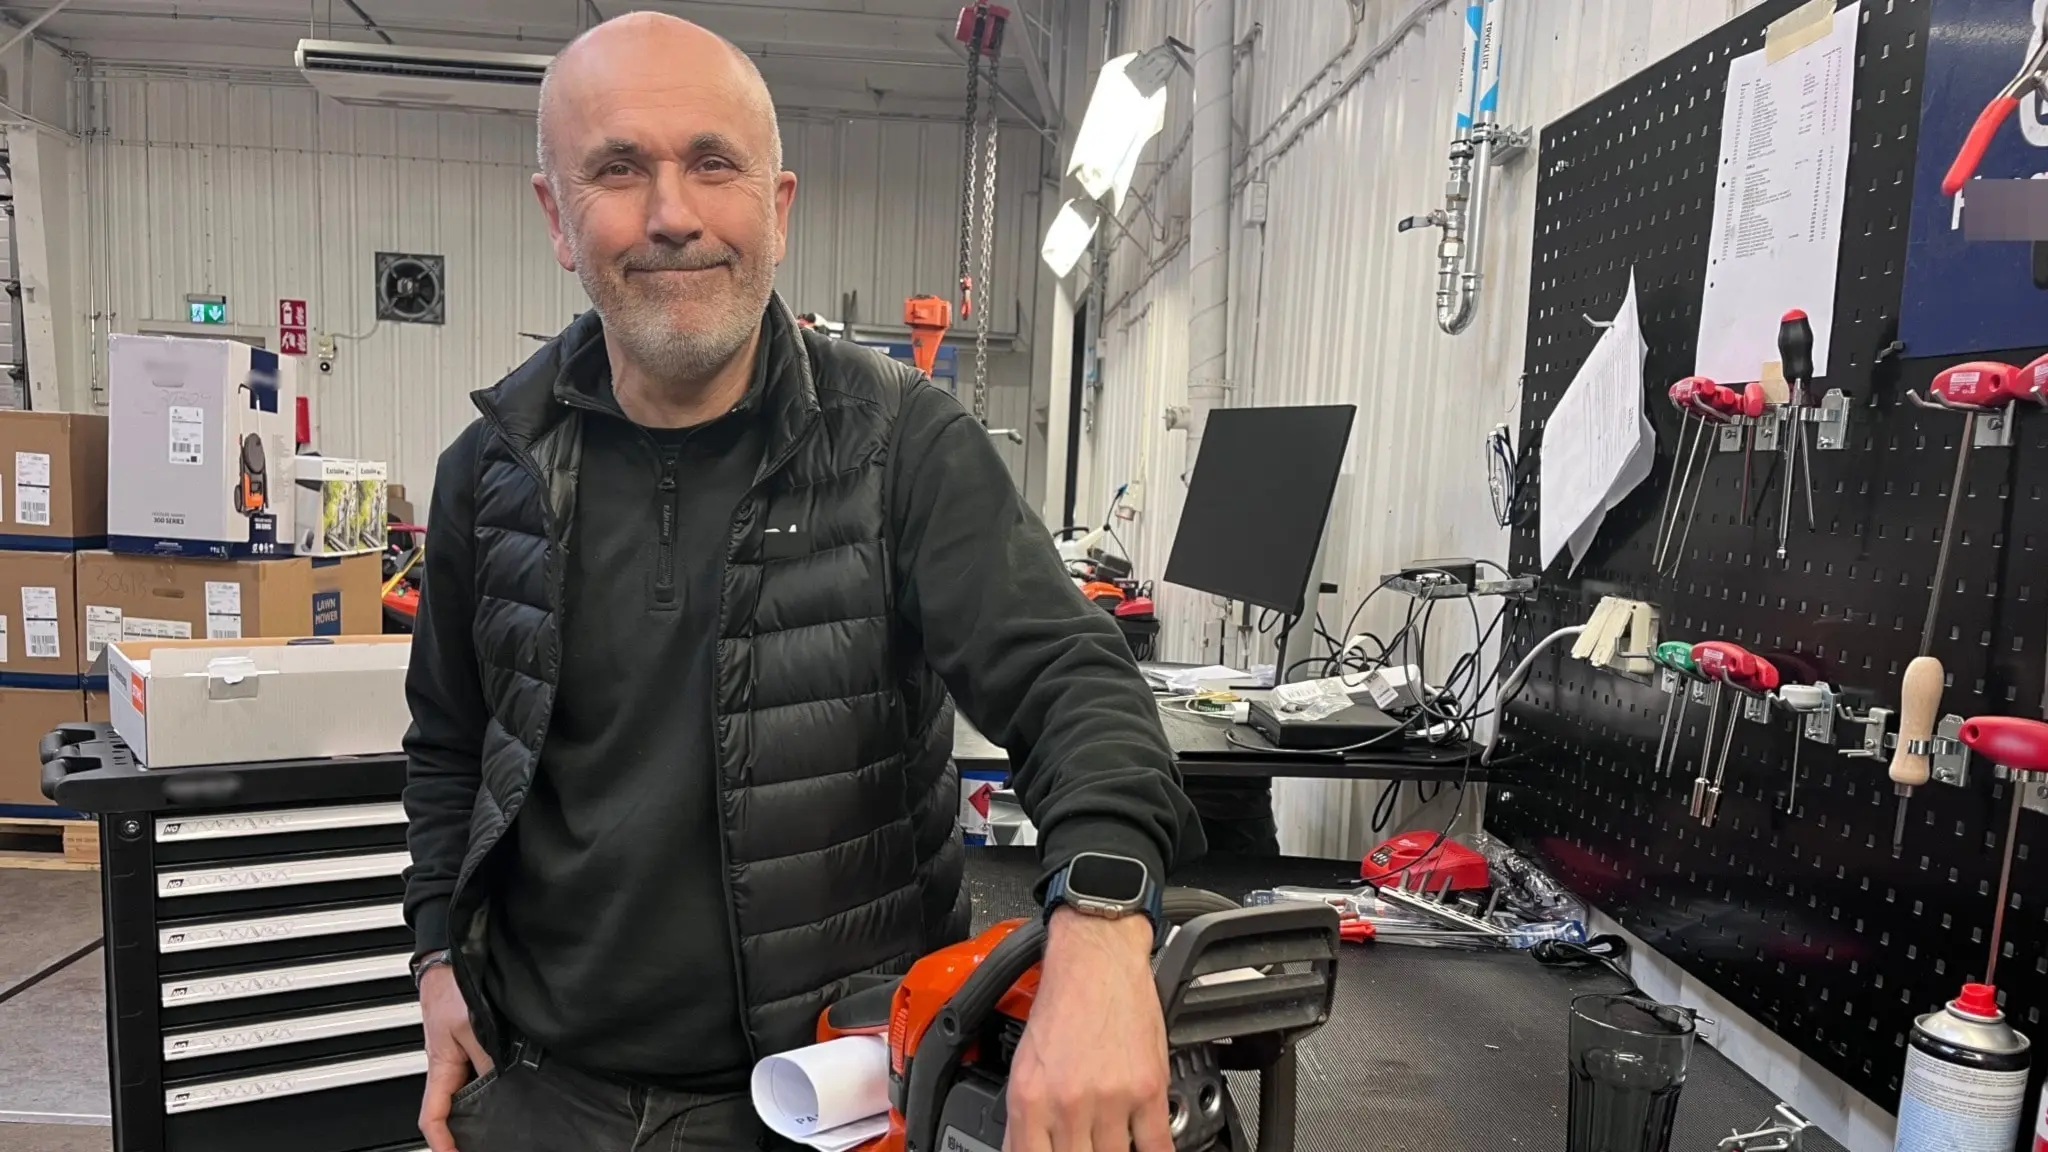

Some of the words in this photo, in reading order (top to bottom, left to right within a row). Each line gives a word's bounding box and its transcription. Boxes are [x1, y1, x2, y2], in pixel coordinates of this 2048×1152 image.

[317, 598, 336, 611] LAWN
[315, 610, 338, 624] MOWER
[795, 1114, 818, 1124] PA
